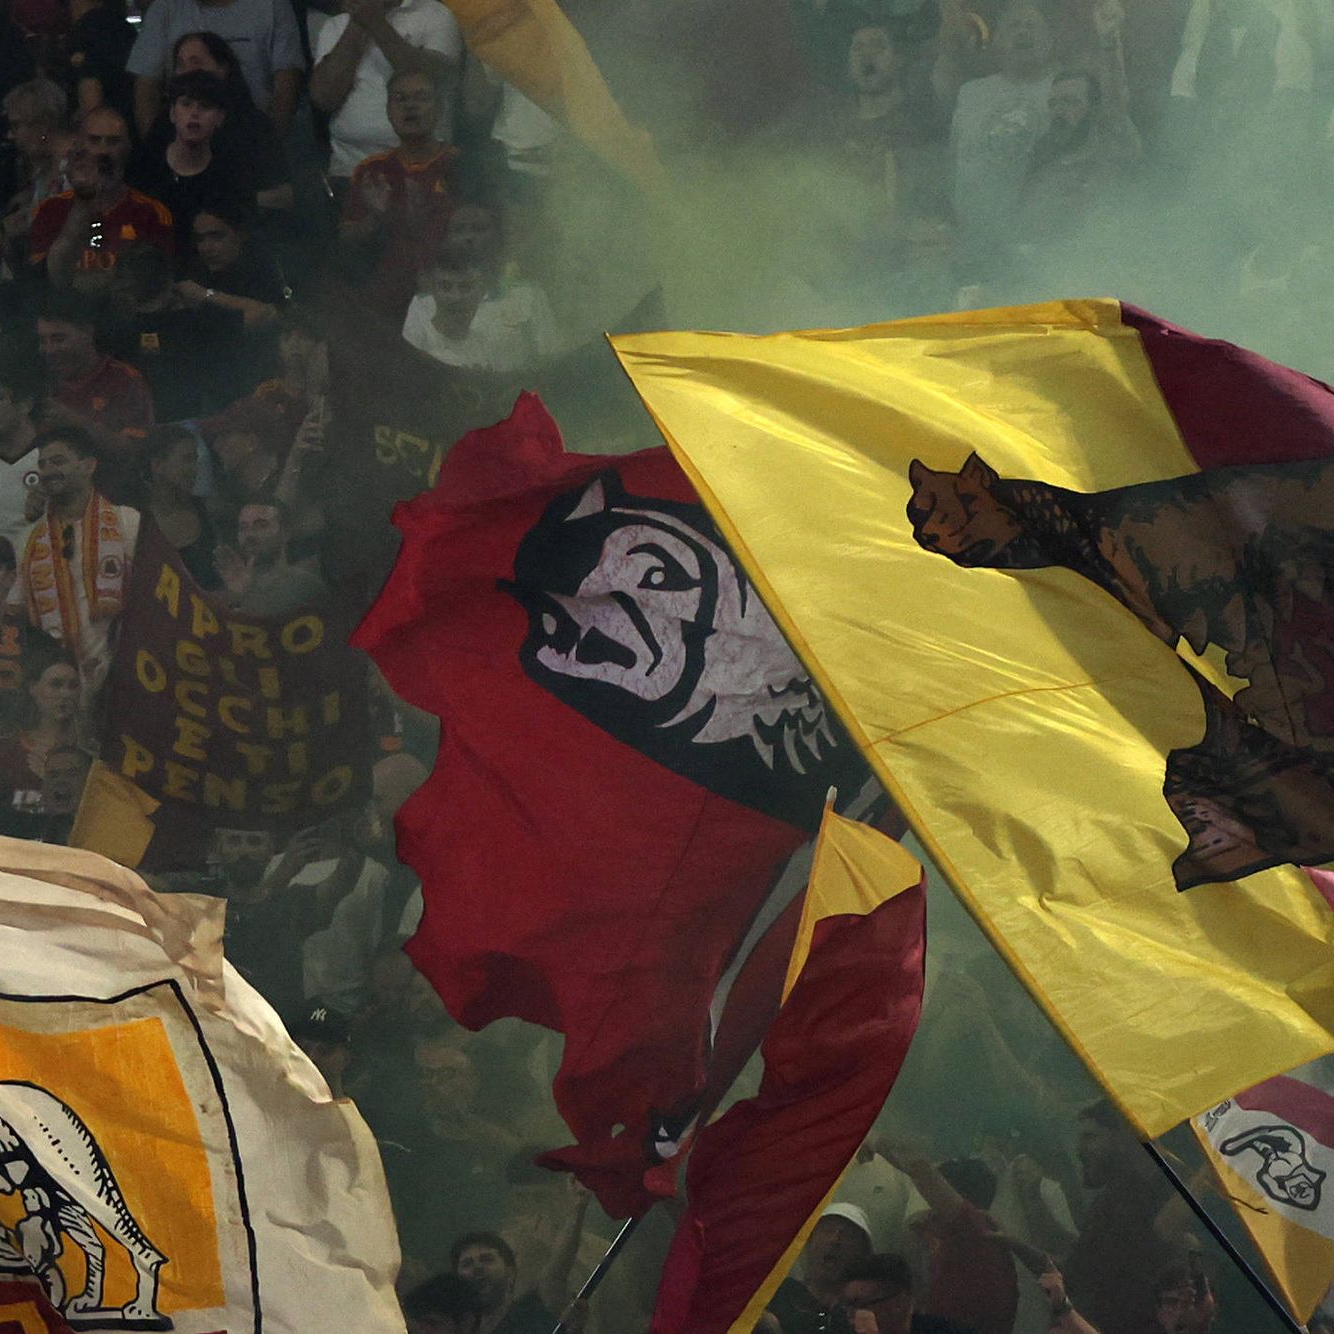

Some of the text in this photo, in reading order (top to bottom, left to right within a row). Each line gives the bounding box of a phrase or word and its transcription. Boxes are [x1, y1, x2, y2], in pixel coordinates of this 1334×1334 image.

[155, 562, 326, 660] APRO
[135, 648, 342, 740] OCCHI
[121, 735, 354, 814] PENSO
[172, 716, 309, 775] E TI
